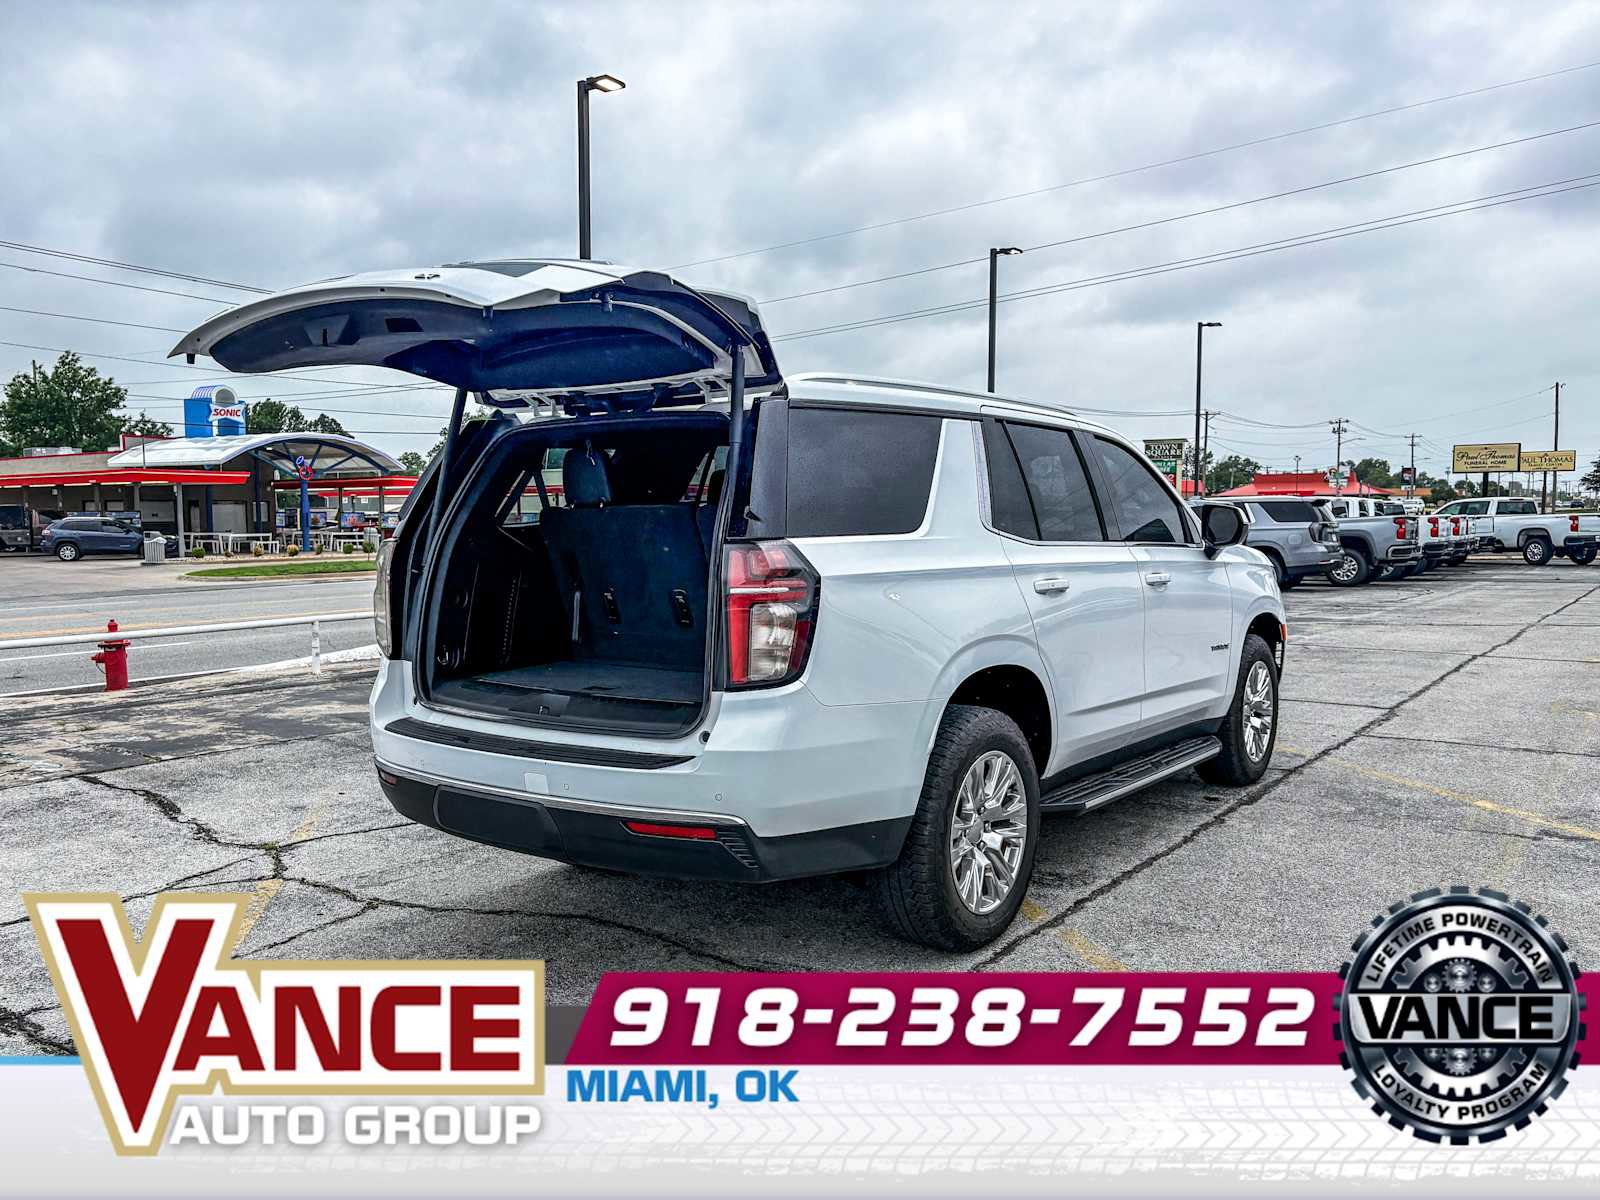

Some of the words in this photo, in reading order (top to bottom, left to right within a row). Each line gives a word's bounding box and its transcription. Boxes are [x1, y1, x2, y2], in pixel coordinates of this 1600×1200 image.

[213, 408, 241, 417] SONIC
[1456, 451, 1480, 461] Paul
[1481, 450, 1516, 460] Thomas
